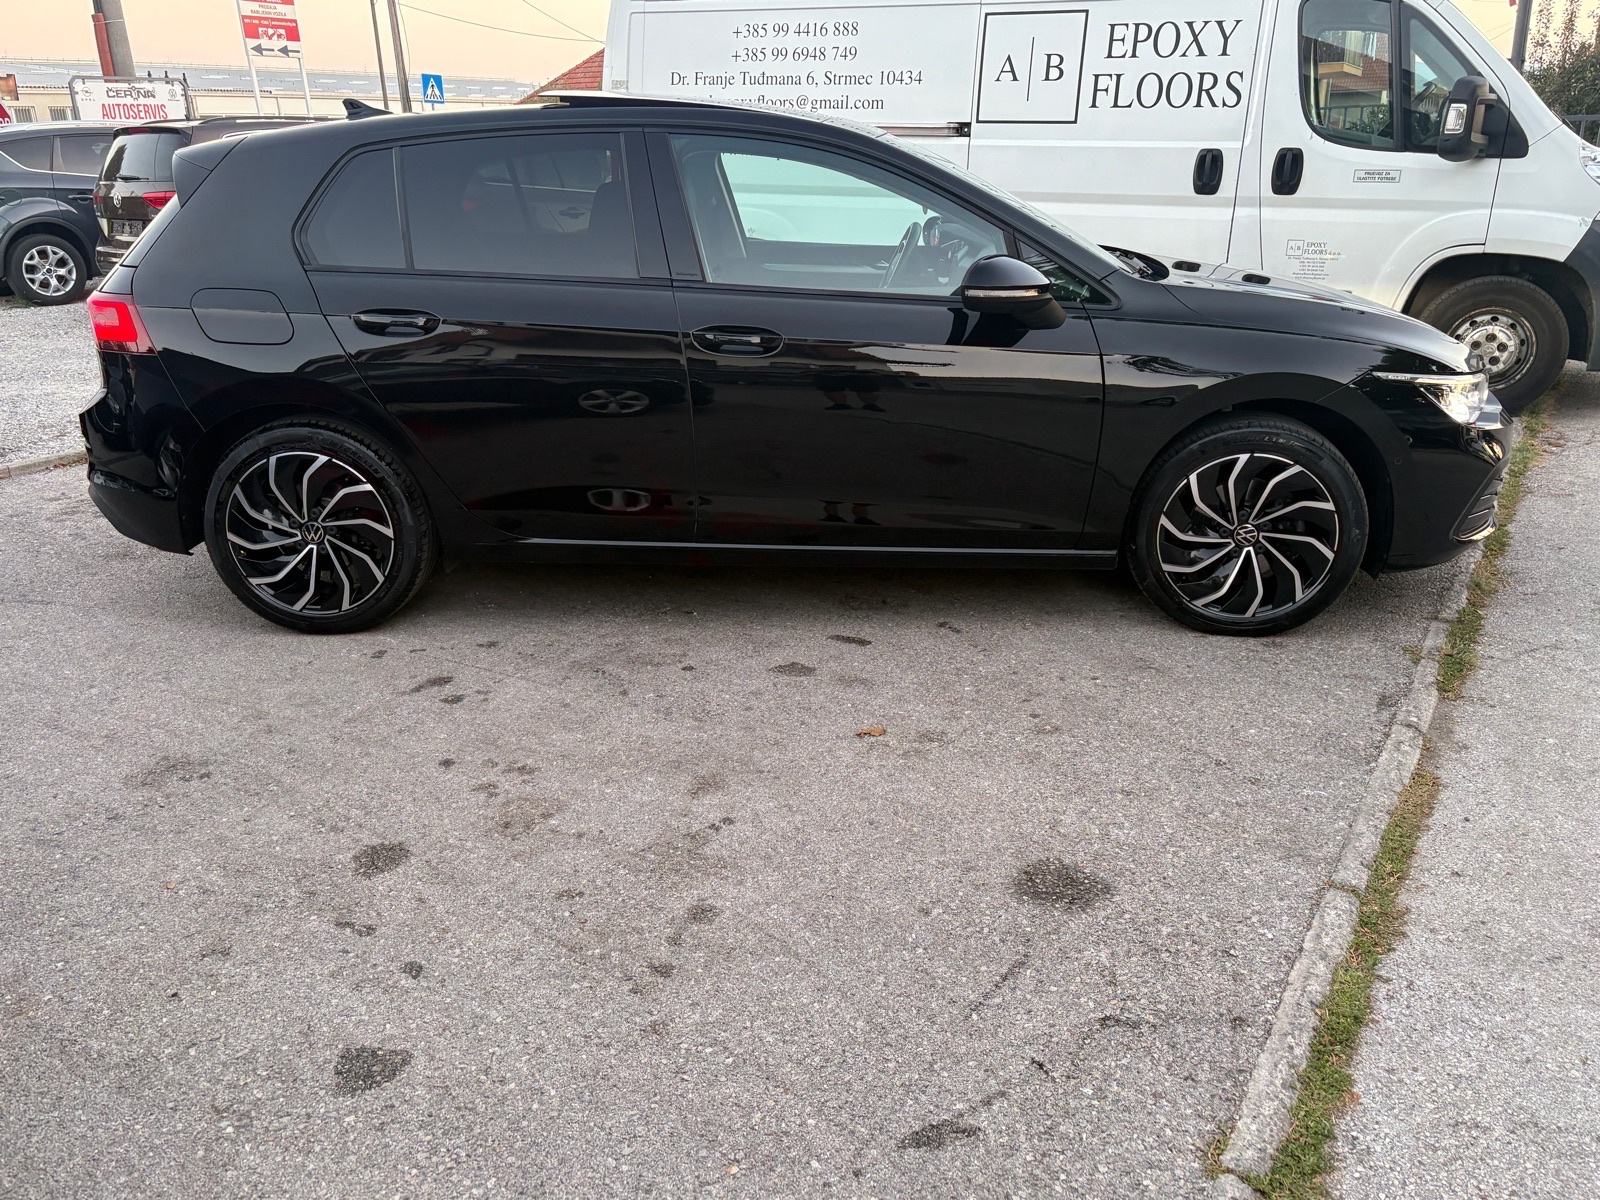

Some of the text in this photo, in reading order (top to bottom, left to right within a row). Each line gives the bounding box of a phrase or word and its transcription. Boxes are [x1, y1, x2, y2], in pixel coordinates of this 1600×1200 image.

[732, 21, 859, 38] +385 99 4416 888
[1104, 19, 1243, 59] EPOXY
[731, 45, 857, 62] +385 99 6948 749
[671, 70, 923, 90] Dr. Franje Tuđmana 6, Strmec 10434
[1088, 70, 1244, 108] FLOORS
[101, 103, 168, 120] AUTOSERVIS
[1306, 241, 1328, 249] EPOXY
